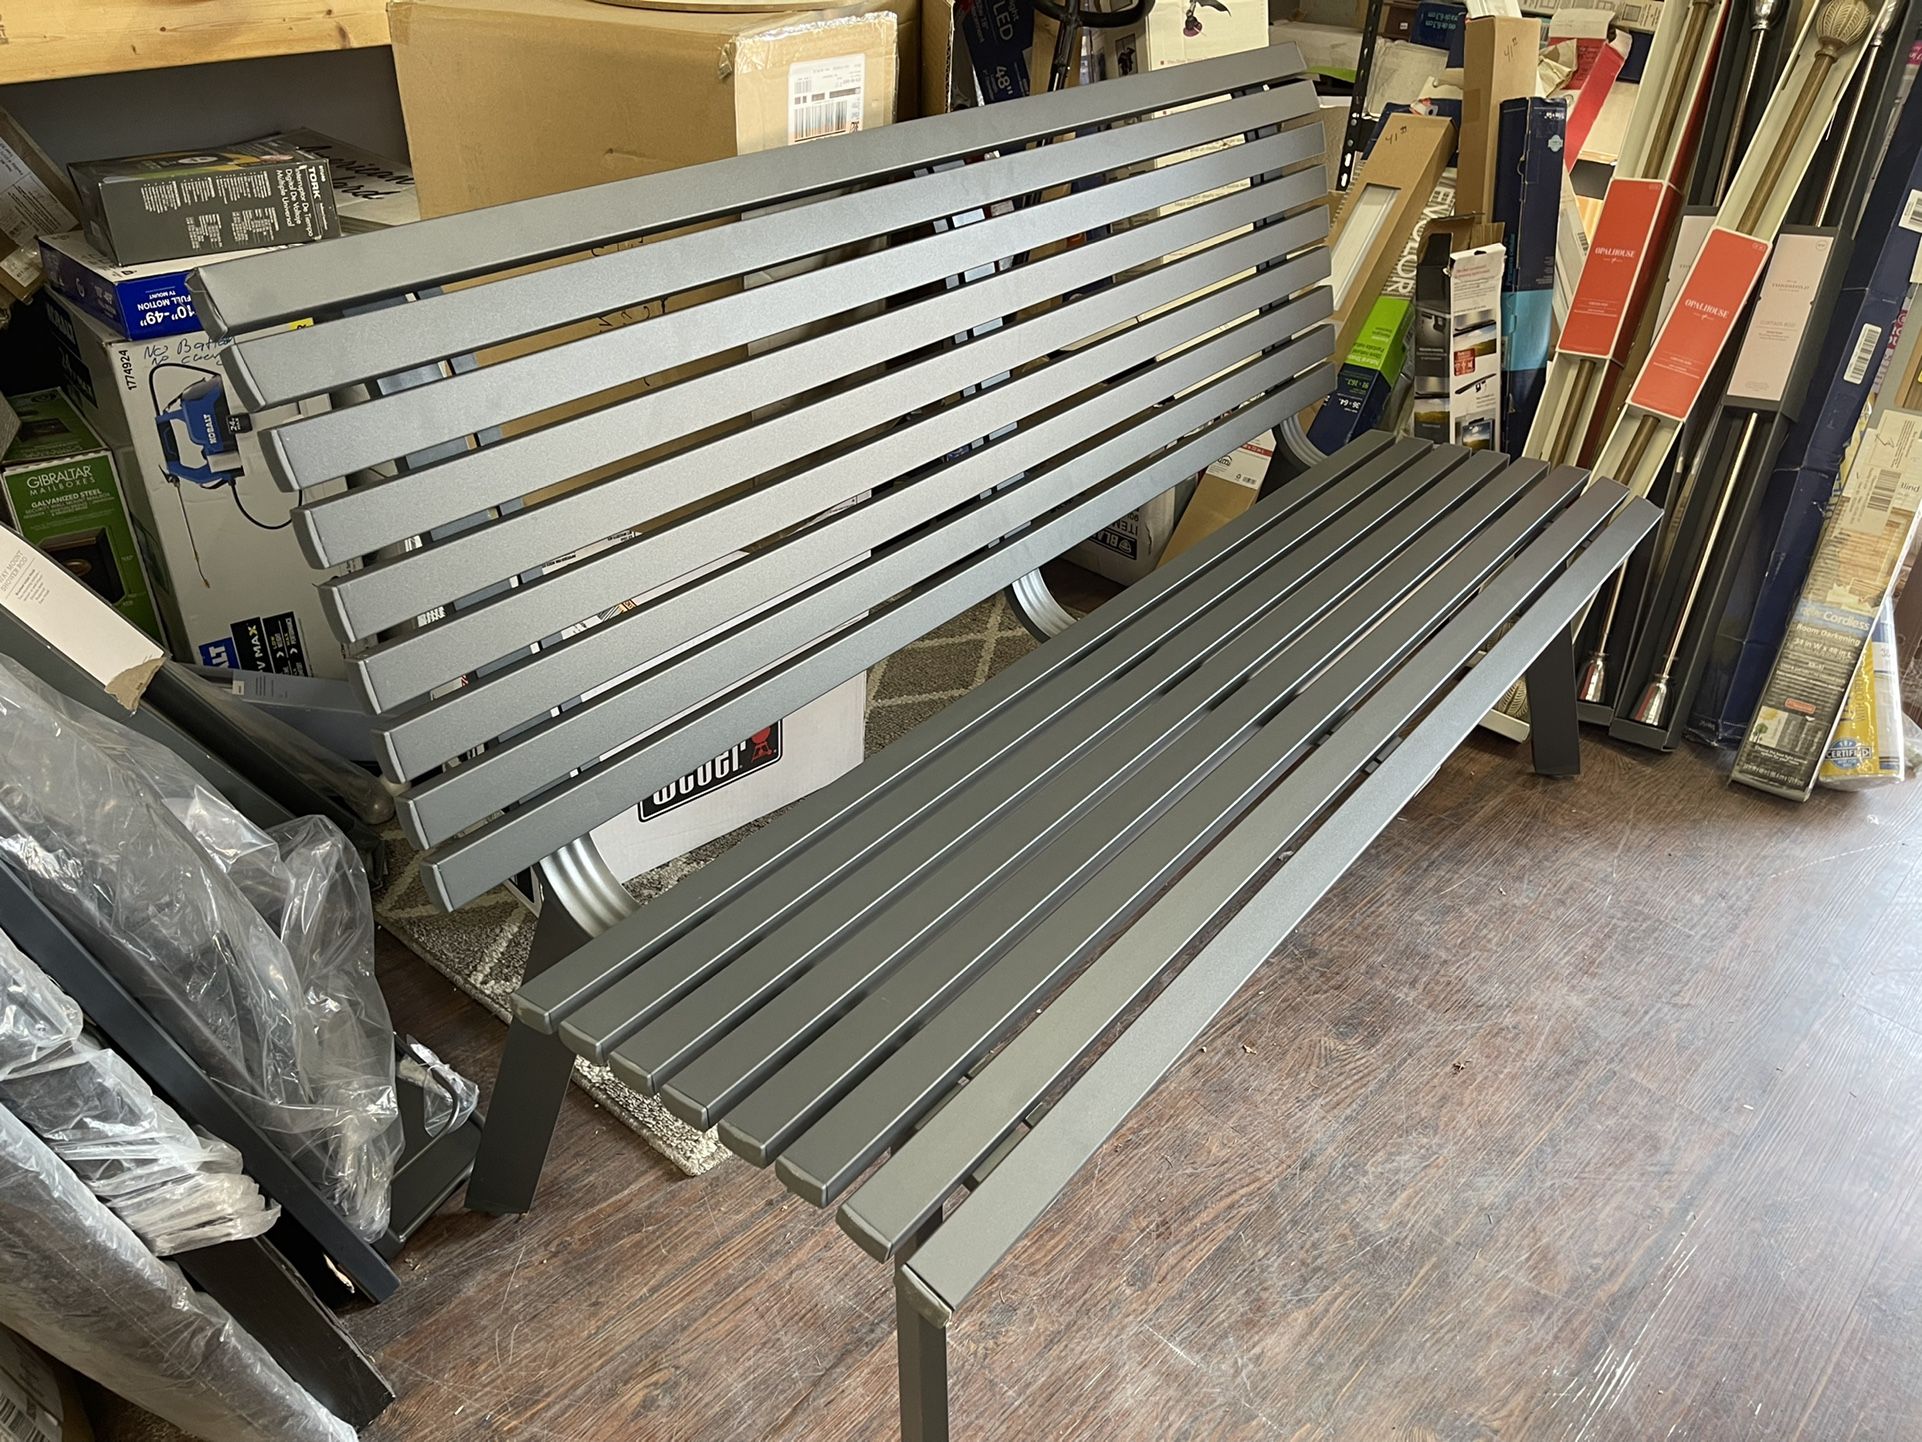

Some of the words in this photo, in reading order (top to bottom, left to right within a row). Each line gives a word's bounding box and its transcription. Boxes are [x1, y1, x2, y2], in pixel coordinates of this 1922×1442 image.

[993, 1, 1013, 40] LED
[995, 66, 1014, 95] 48"
[285, 168, 297, 190] Digital
[308, 166, 321, 199] TORK
[1595, 247, 1635, 258] OPALHOUSE
[137, 299, 170, 311] MOTION
[171, 294, 192, 304] FULL
[1685, 298, 1729, 318] OPALHOUSE
[118, 349, 137, 391] 1774924
[203, 414, 217, 444] KOBALT
[27, 465, 91, 488] GIBRALTAR
[30, 477, 96, 496] MAILBOXES
[32, 492, 80, 508] GALVANIZED
[80, 488, 102, 498] STEEL
[1822, 610, 1870, 631] Cordless
[248, 624, 264, 658] MAX
[1796, 623, 1818, 635] Room
[1819, 629, 1861, 646] Darkening
[1826, 748, 1869, 758] CERTIFID
